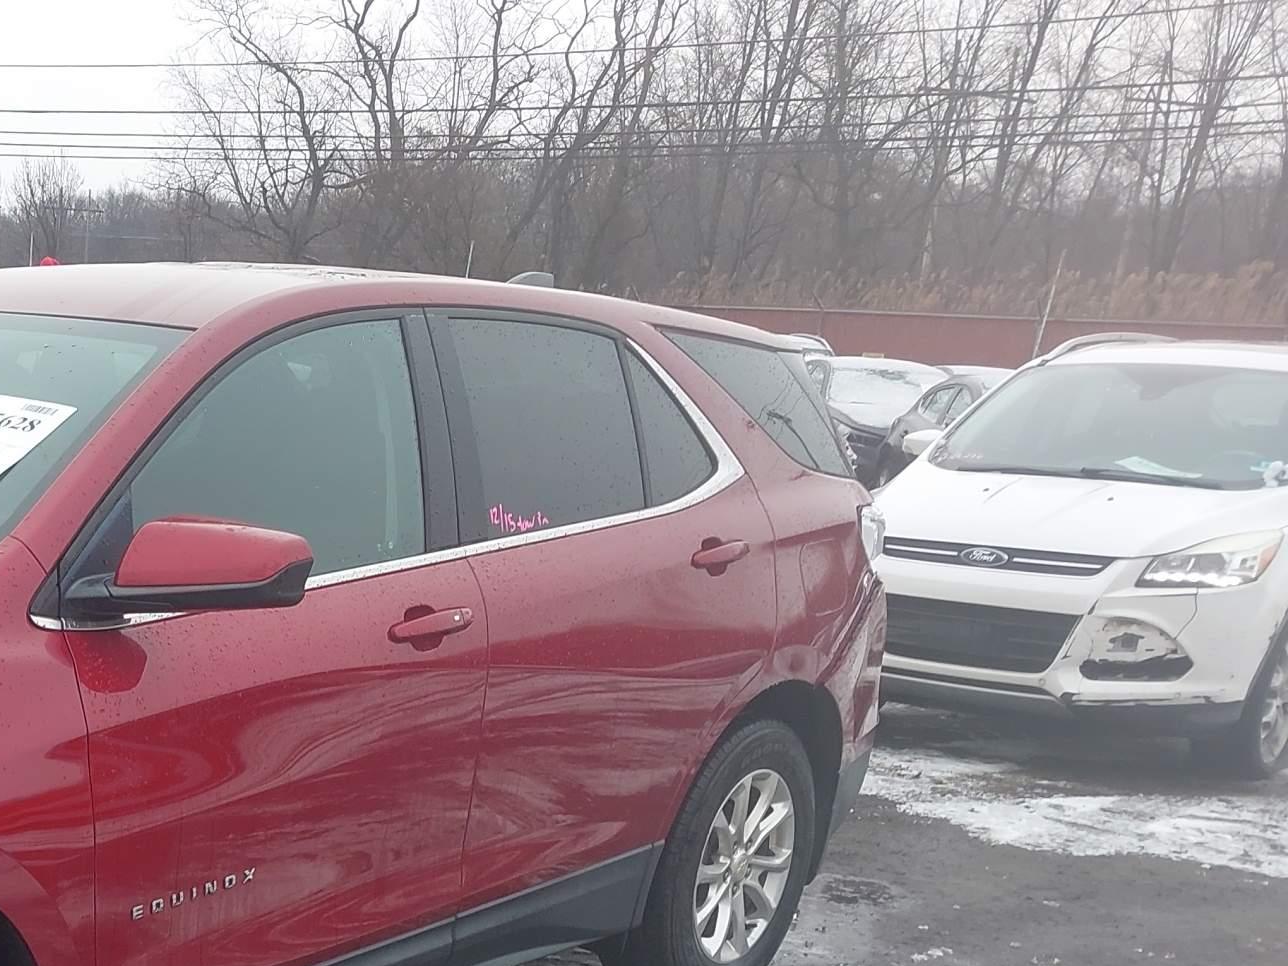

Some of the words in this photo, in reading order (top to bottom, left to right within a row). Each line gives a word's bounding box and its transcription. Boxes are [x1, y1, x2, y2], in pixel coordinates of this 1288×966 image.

[490, 504, 516, 532] 12/15
[968, 549, 997, 562] Ford
[131, 867, 256, 921] EQUINOX
